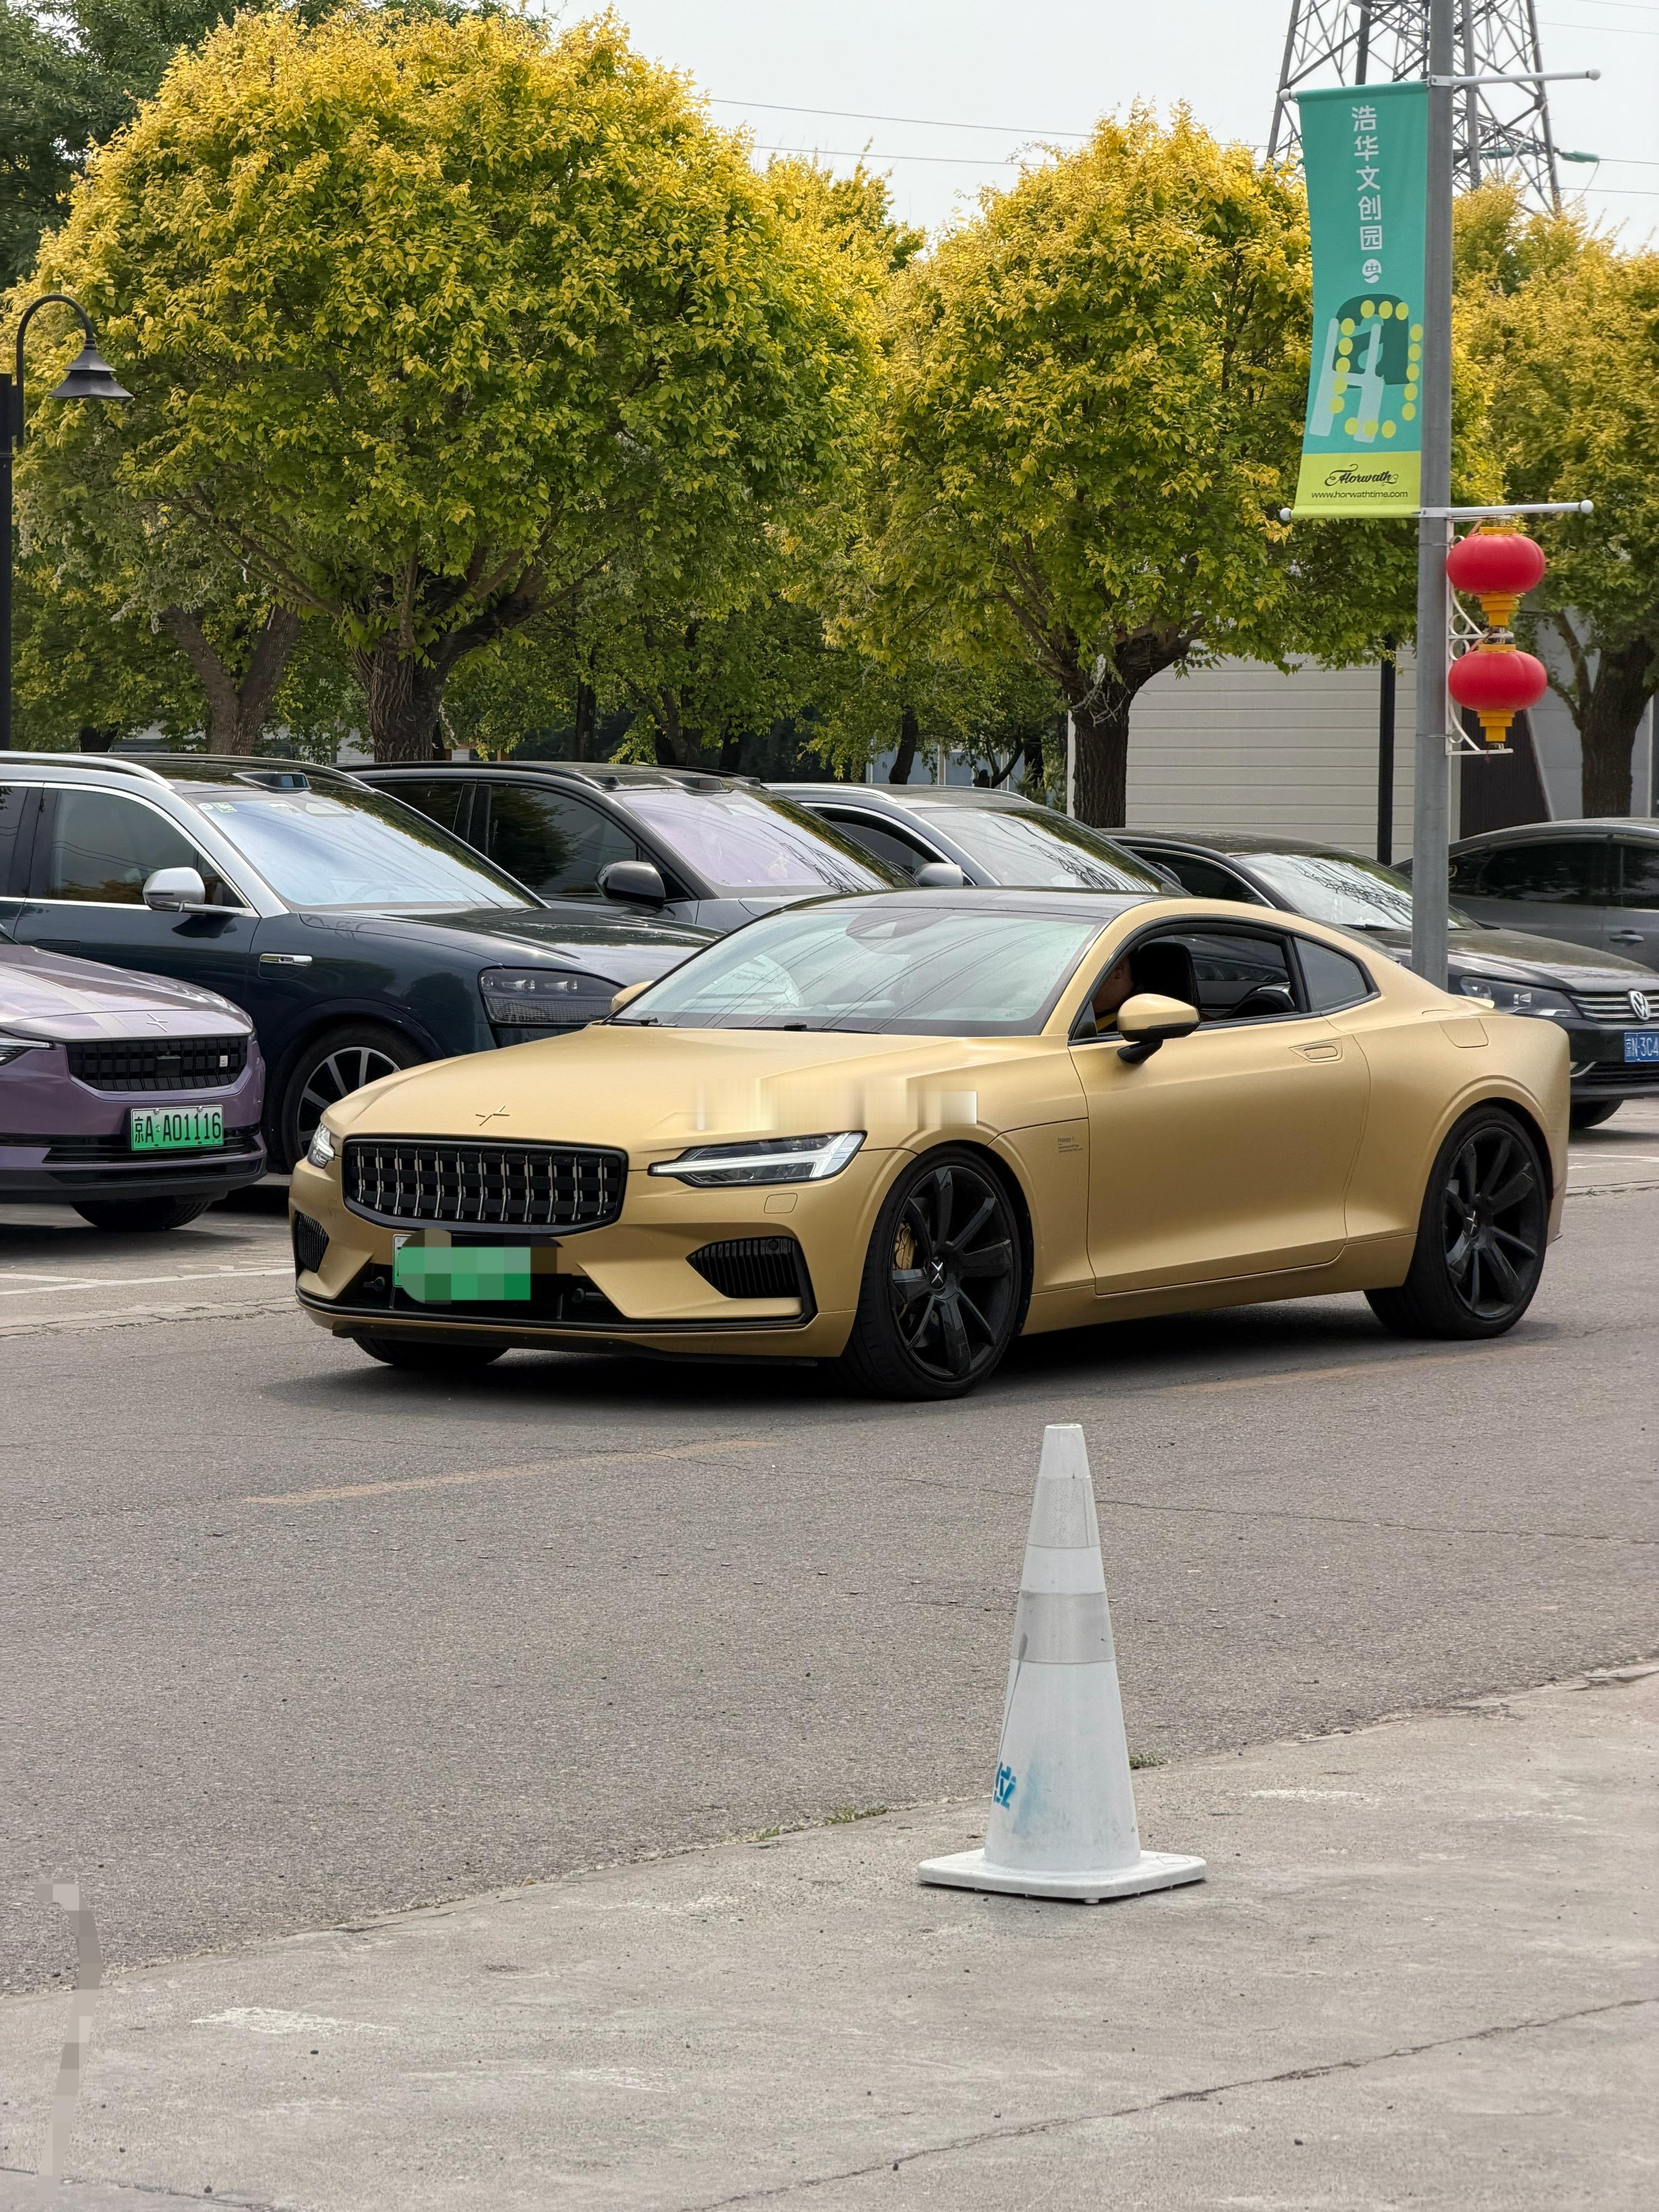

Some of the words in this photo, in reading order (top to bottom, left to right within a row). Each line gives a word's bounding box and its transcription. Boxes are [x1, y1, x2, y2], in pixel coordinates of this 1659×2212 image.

[1351, 105, 1383, 251] 浩华文创园
[1324, 463, 1399, 486] Horwath
[1311, 490, 1408, 498] www.horwathtime.com
